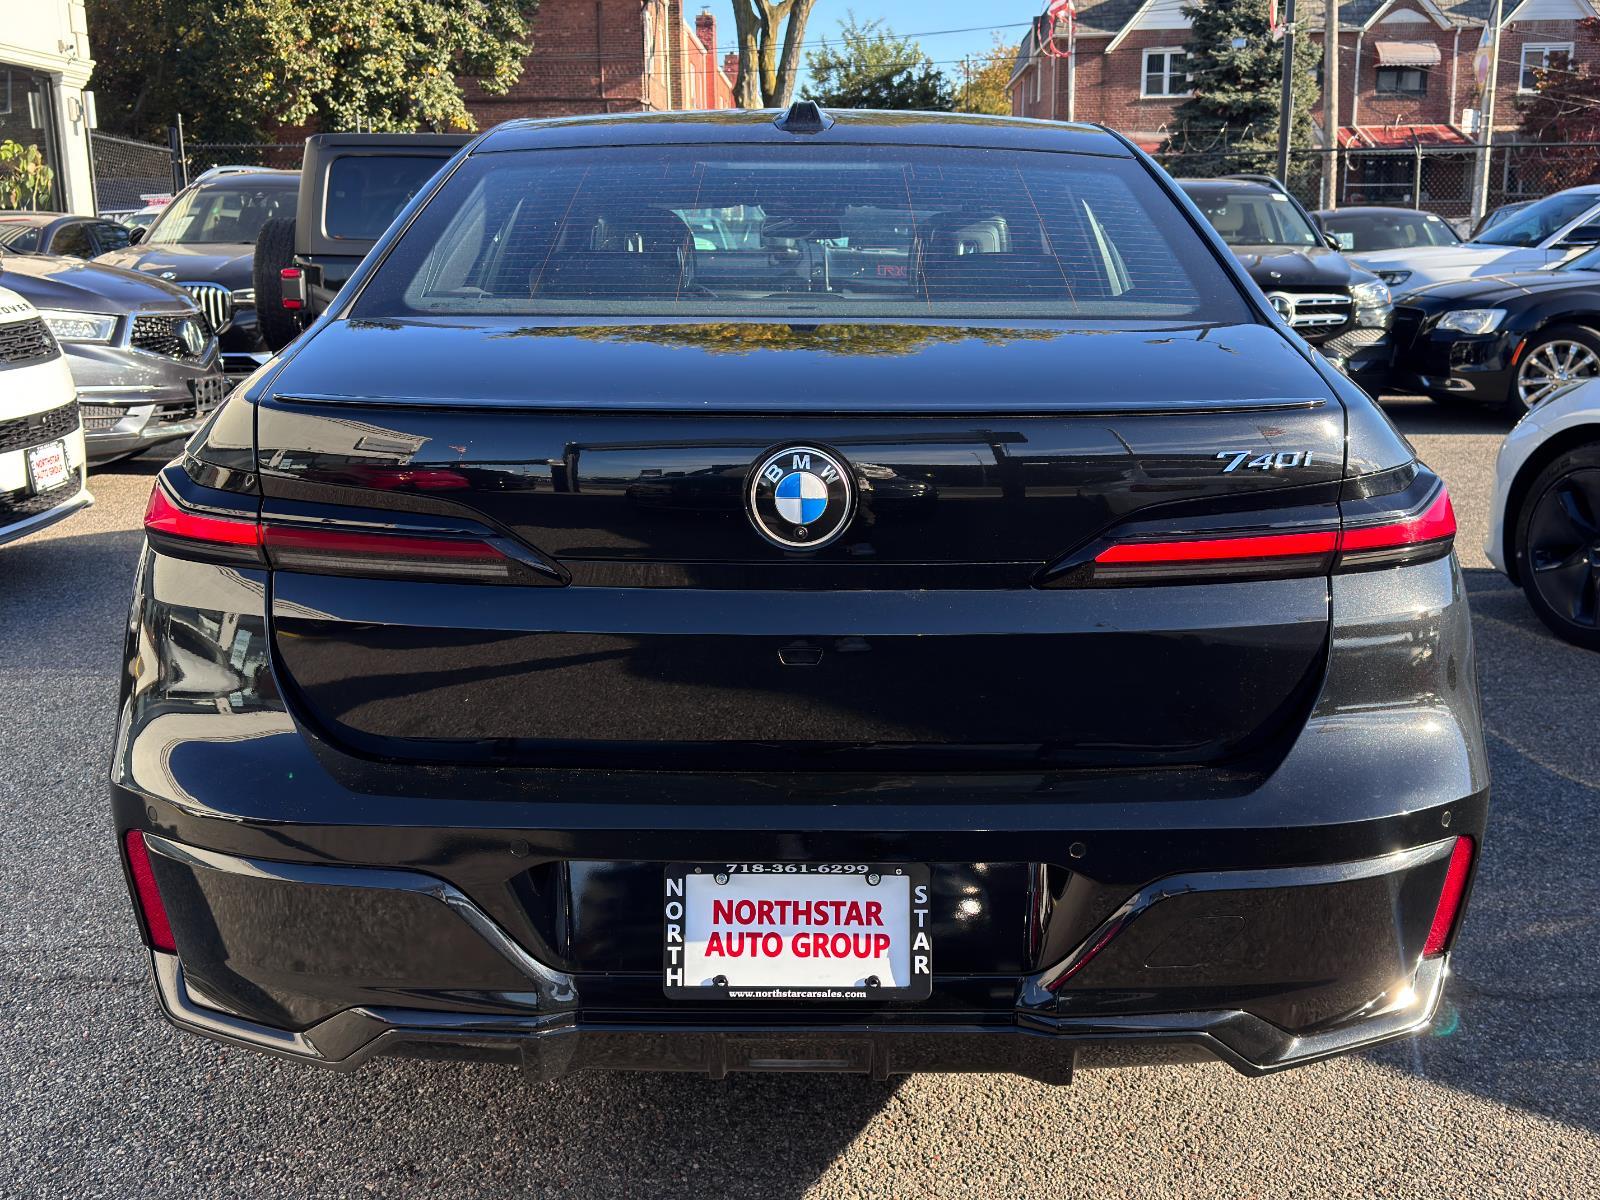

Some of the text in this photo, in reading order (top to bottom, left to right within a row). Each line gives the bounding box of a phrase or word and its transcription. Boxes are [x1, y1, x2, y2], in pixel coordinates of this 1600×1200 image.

[764, 454, 840, 485] BMW
[1216, 450, 1314, 473] 740i
[726, 863, 870, 874] 718-361-6299
[712, 899, 885, 927] NORTHSTAR
[665, 878, 684, 987] NORTH
[912, 885, 931, 975] STAR
[704, 931, 891, 959] AUTO GROUP
[728, 988, 867, 998] www.northstarcarsales.com
